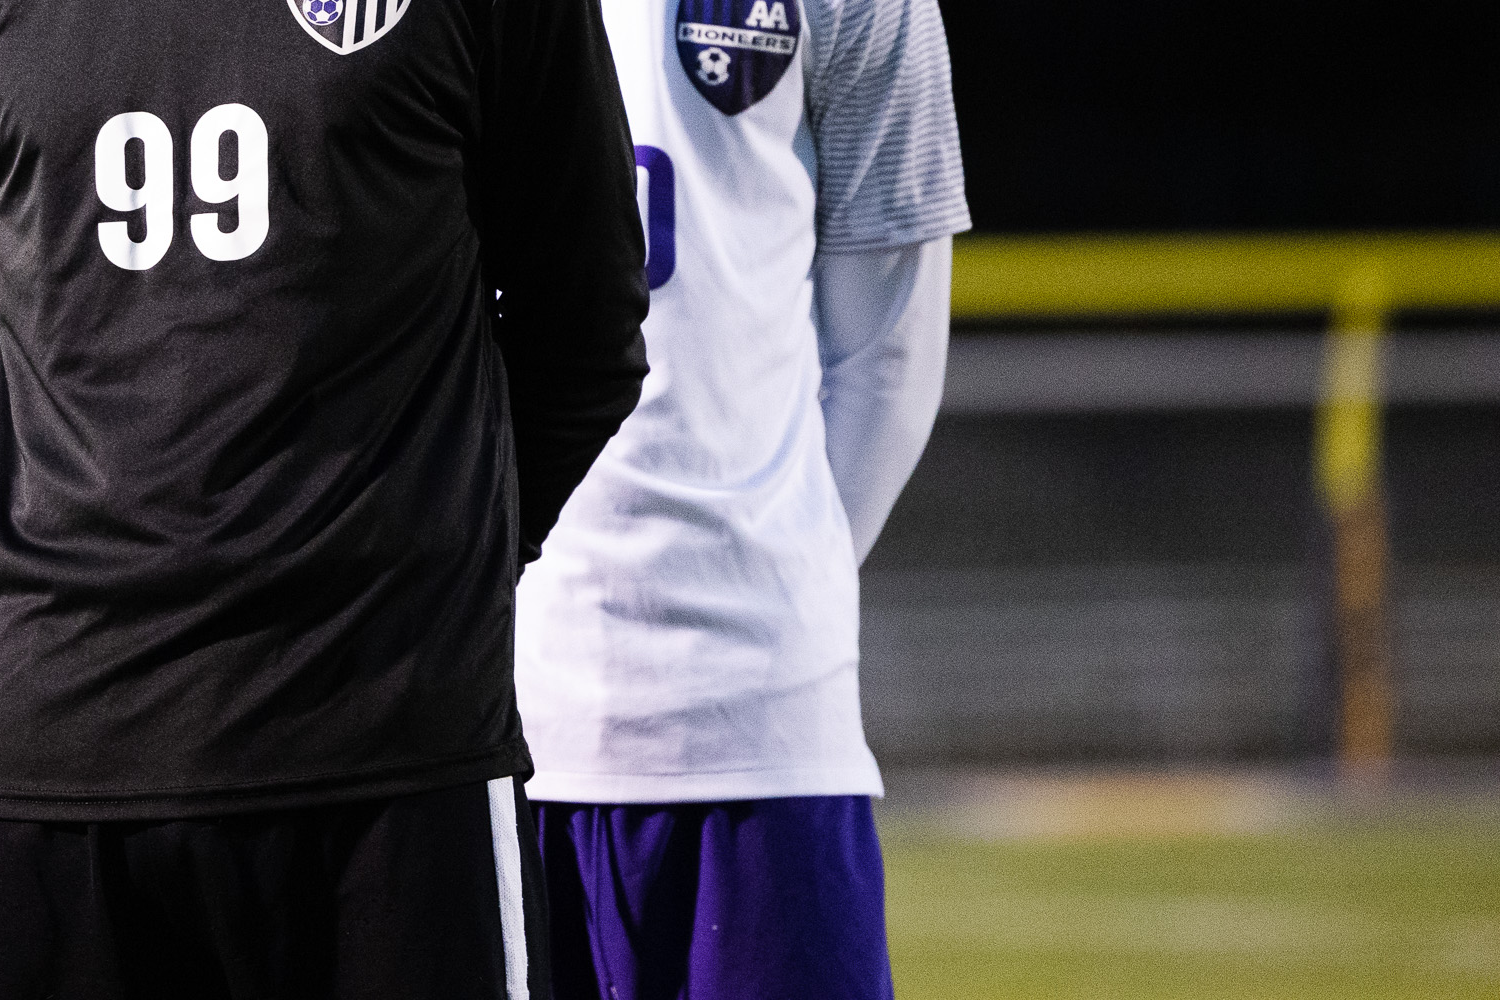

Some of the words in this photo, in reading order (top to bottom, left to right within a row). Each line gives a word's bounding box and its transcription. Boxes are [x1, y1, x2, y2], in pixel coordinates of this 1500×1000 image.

[744, 0, 790, 31] AA
[682, 27, 791, 51] PIONEERS
[95, 102, 269, 271] 99
